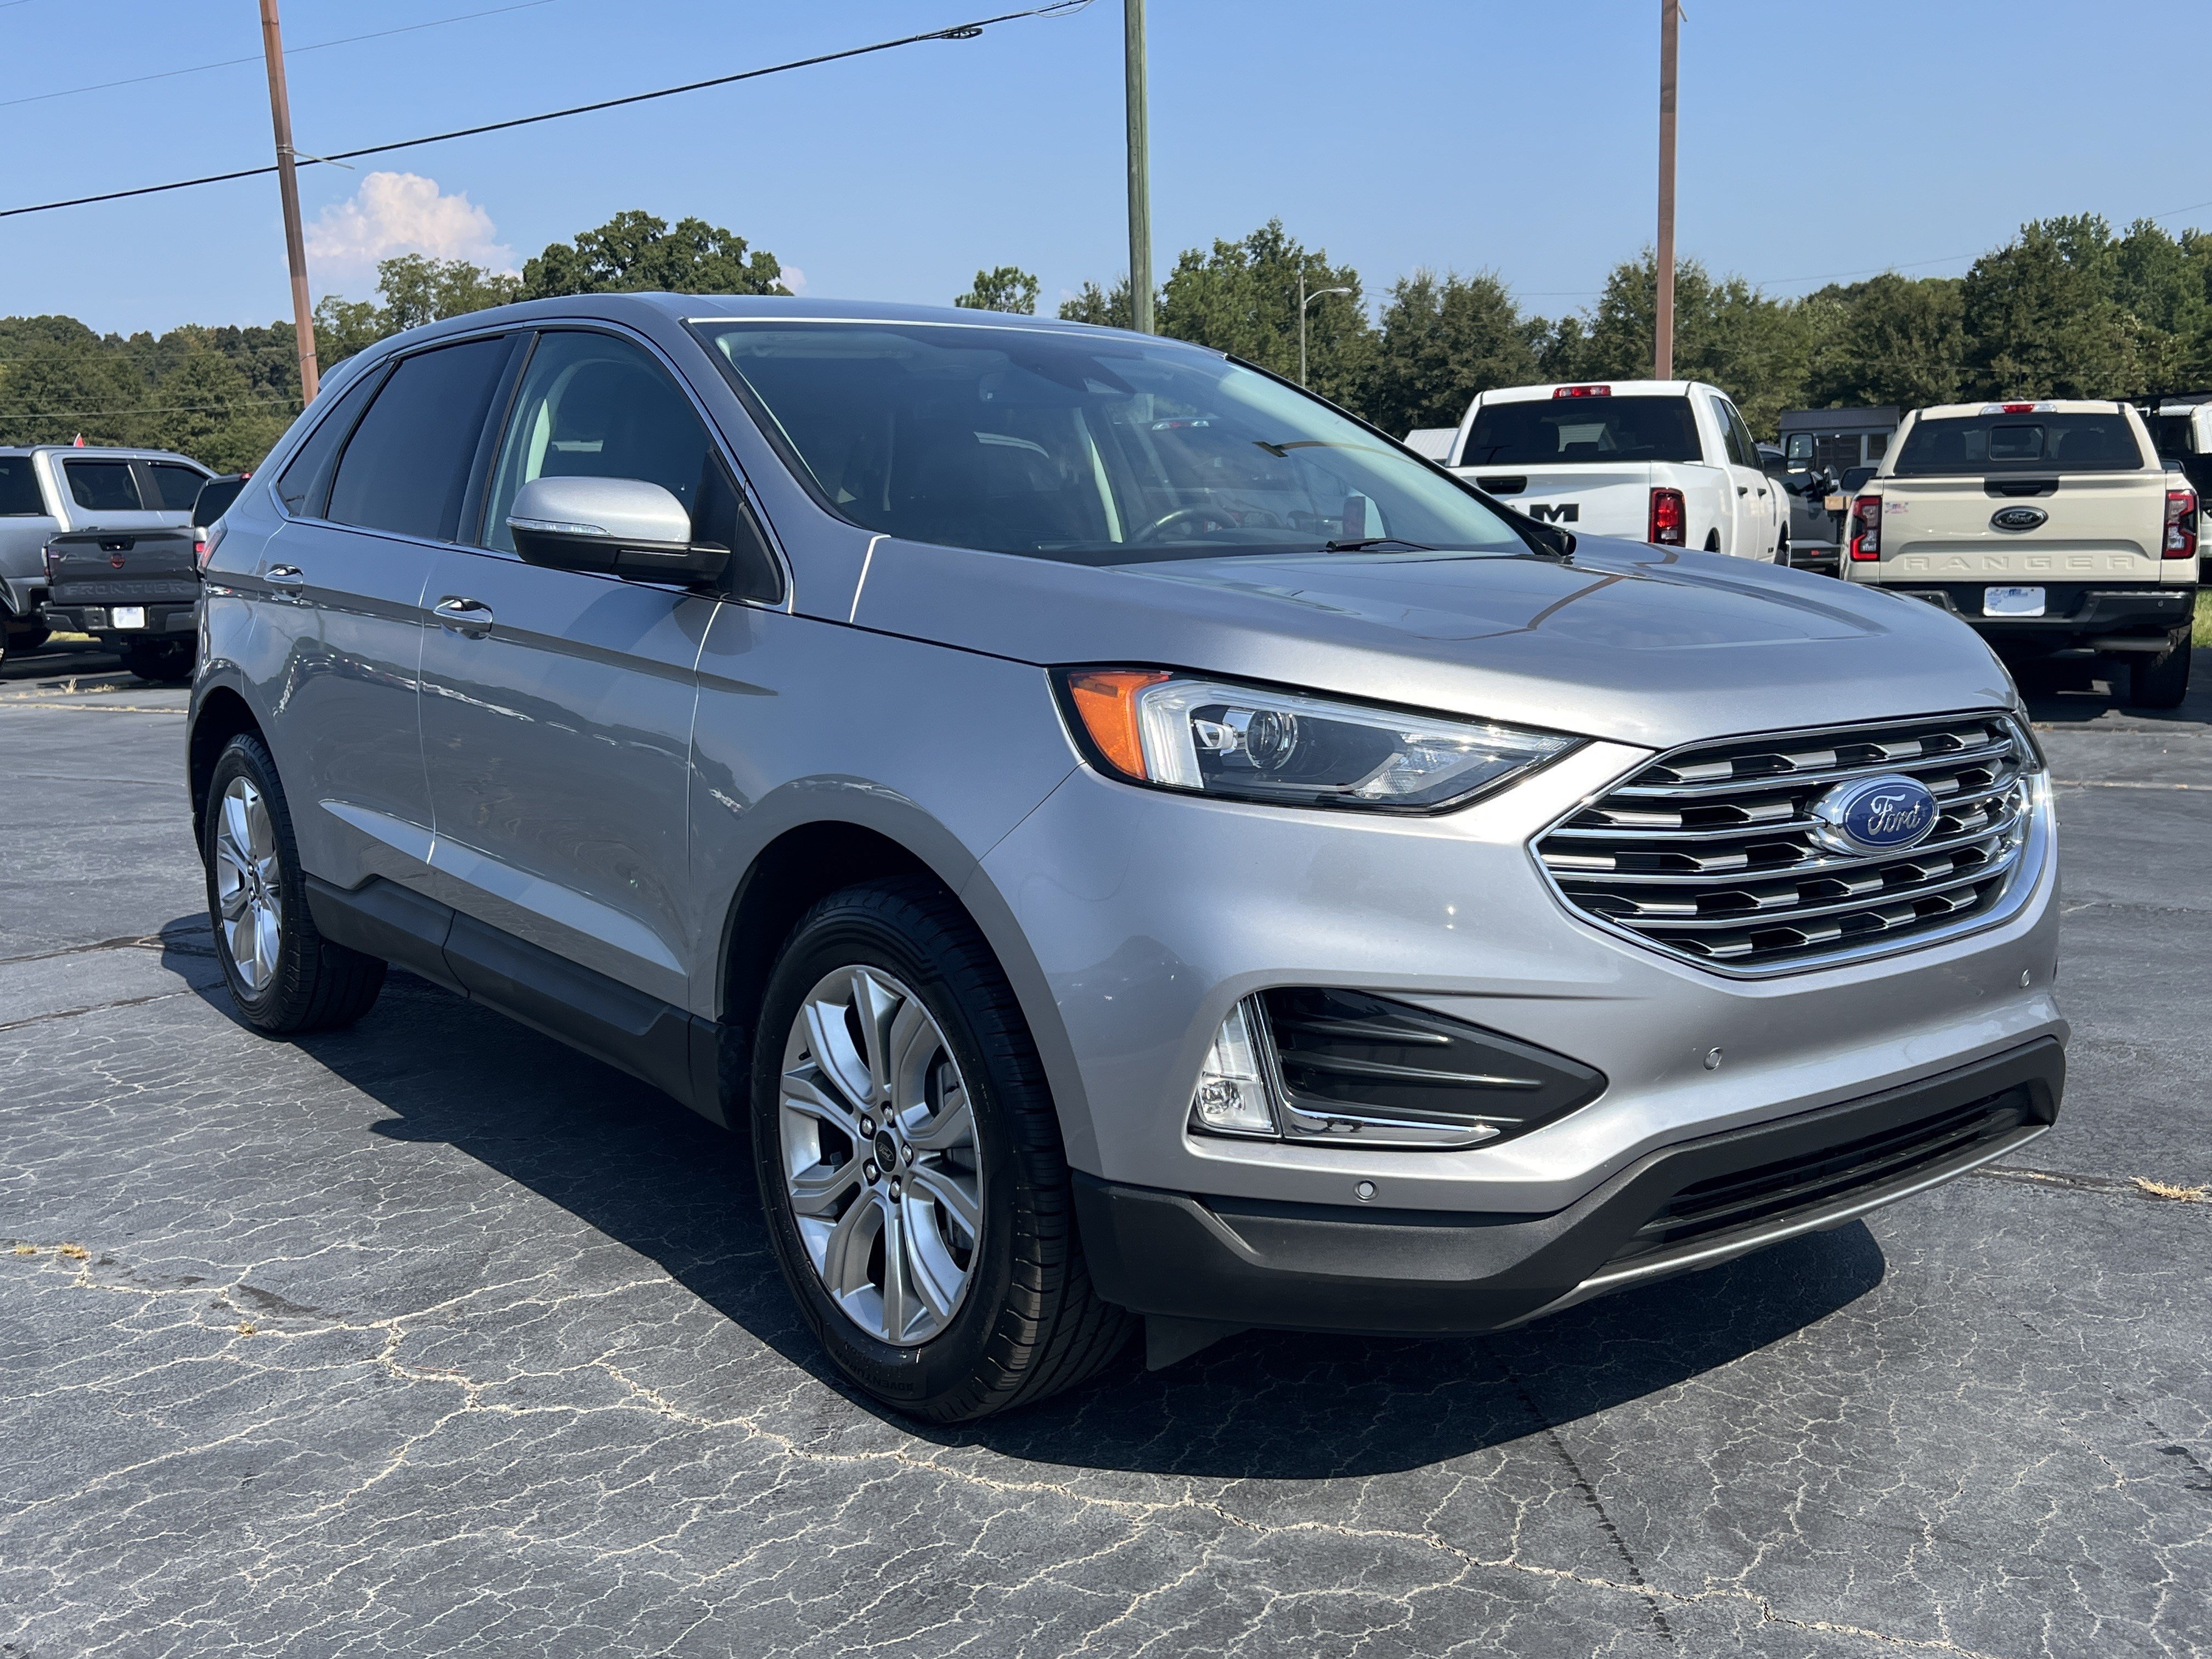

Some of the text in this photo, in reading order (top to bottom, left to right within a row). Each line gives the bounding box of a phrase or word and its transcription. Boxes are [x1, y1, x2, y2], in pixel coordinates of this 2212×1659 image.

[2006, 511, 2033, 523] Ford
[1904, 556, 2135, 571] RANGER
[63, 582, 185, 596] FRONTIER
[1867, 793, 1921, 836] Ford
[878, 1143, 892, 1159] Ford
